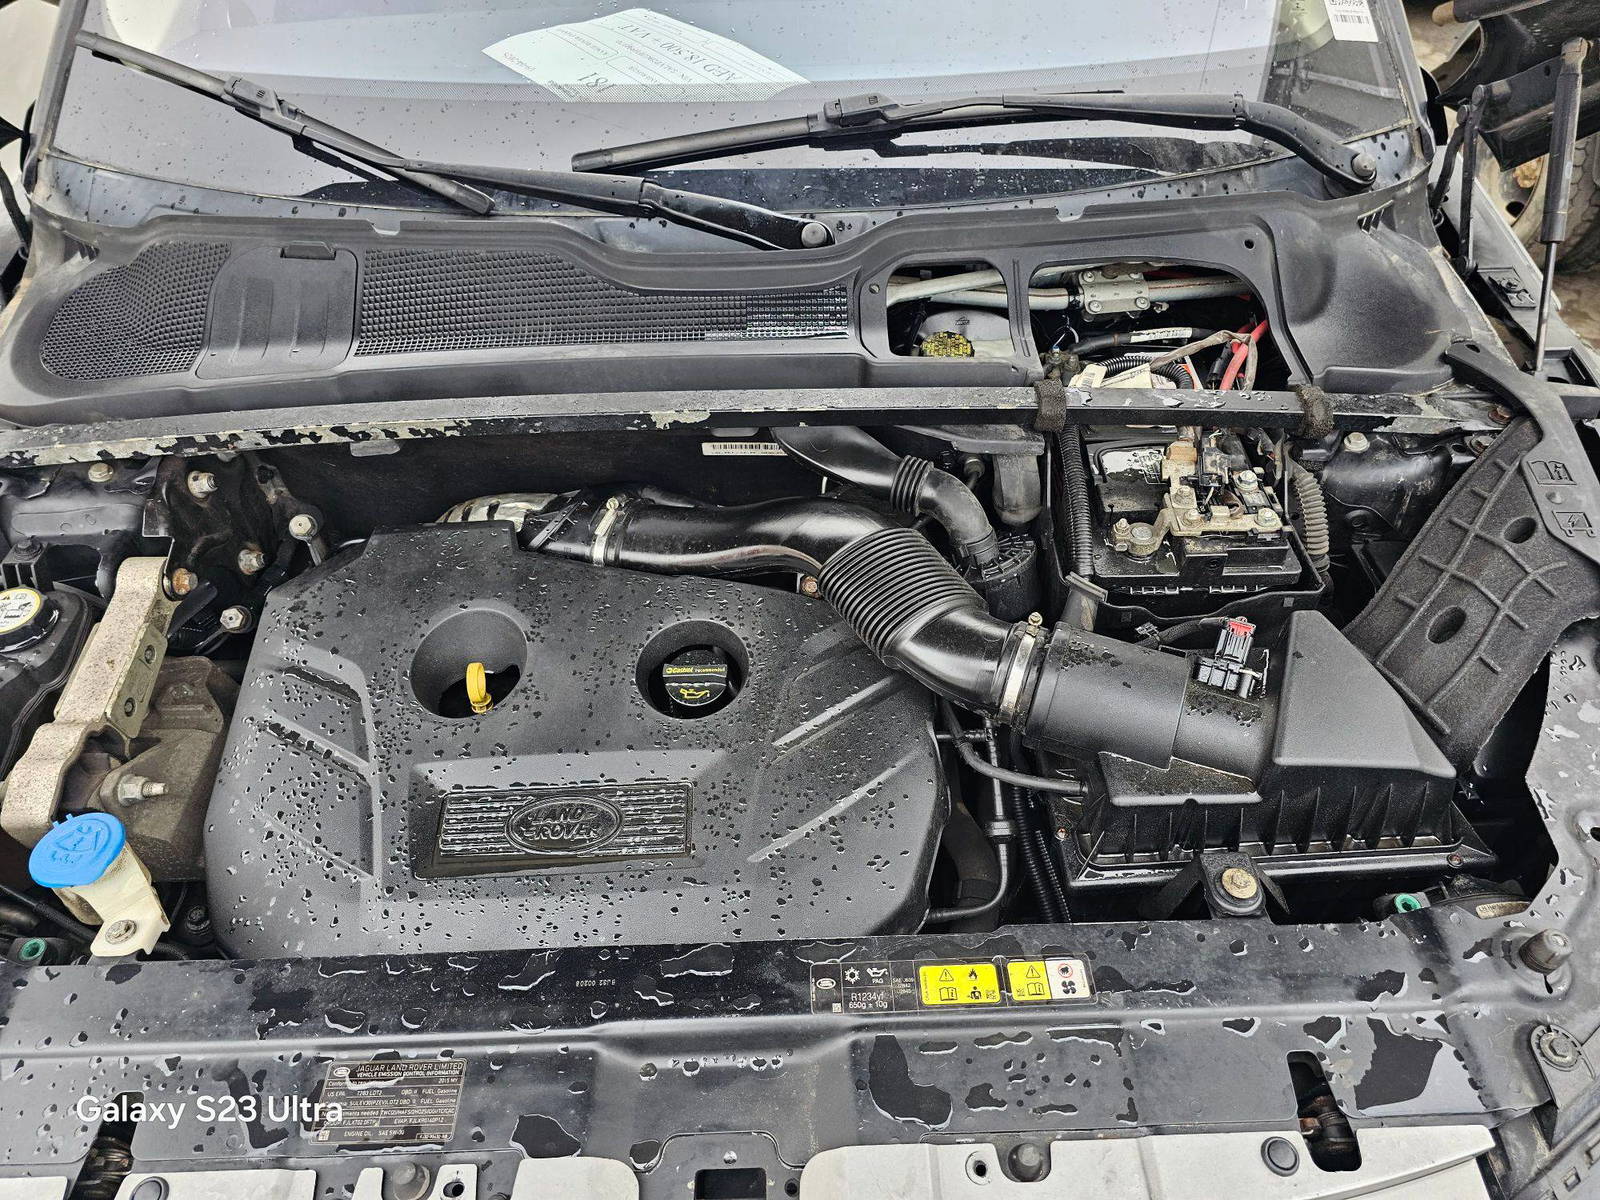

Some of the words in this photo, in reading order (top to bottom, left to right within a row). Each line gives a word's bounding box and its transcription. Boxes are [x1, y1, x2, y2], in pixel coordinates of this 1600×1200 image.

[618, 24, 650, 39] VAT
[703, 63, 743, 82] AED
[534, 822, 599, 841] ROVER
[851, 991, 884, 1001] R1234yf
[875, 1001, 888, 1009] 10g
[356, 1064, 386, 1072] JAGUAR
[386, 1063, 408, 1071] LAND
[408, 1062, 433, 1071] ROVER
[433, 1062, 464, 1070] LIMITED
